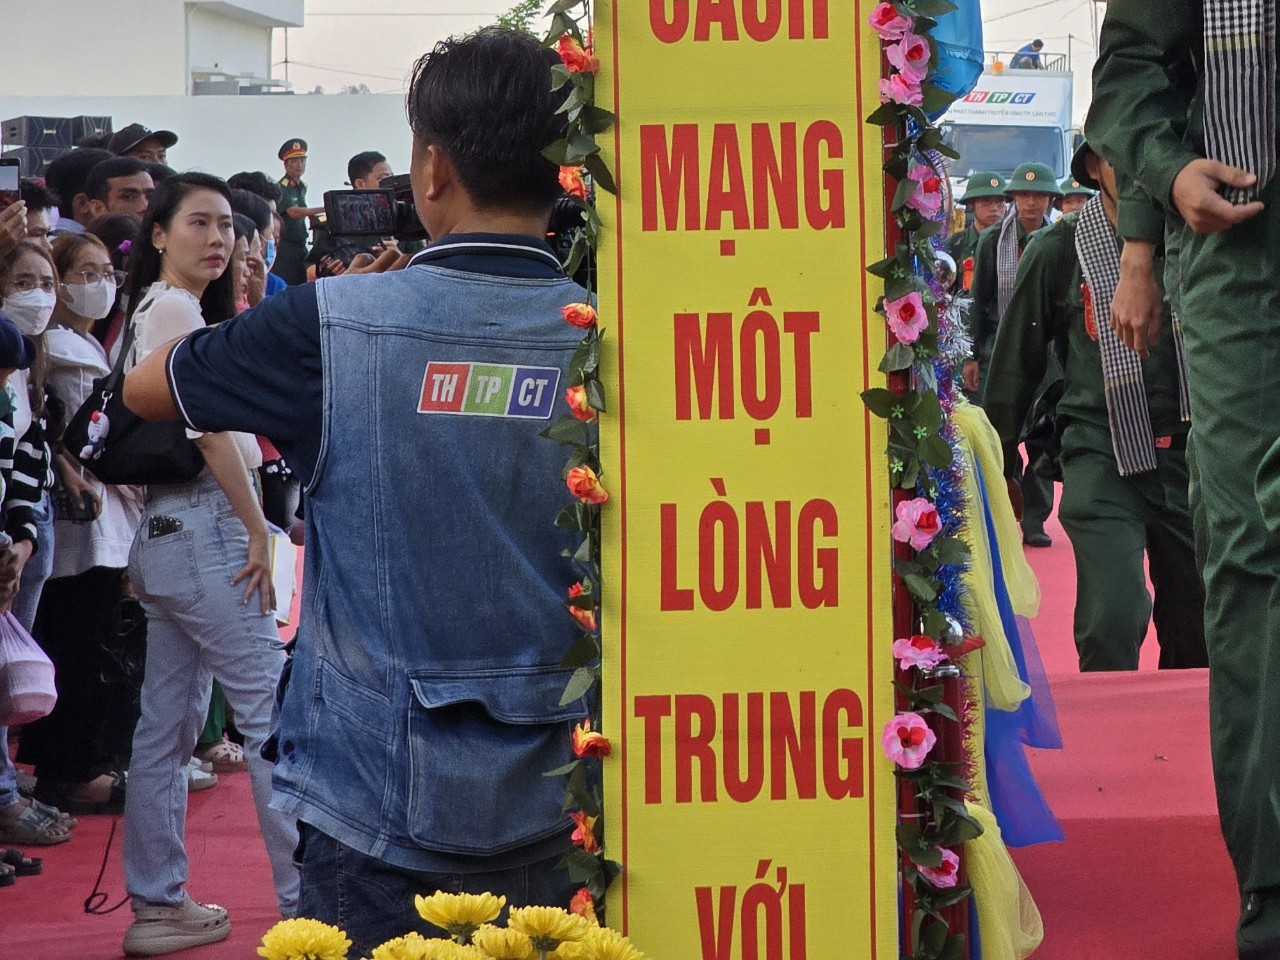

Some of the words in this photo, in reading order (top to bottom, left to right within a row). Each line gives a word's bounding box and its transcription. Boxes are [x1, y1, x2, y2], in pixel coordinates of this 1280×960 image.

[640, 120, 845, 256] MẠNG
[431, 373, 459, 402] TH
[475, 375, 501, 404] TP
[518, 378, 548, 407] CT
[674, 287, 820, 445] MỘT
[660, 478, 839, 612] LÒNG
[634, 688, 864, 804] TRUNG
[695, 859, 806, 960] VỚI
